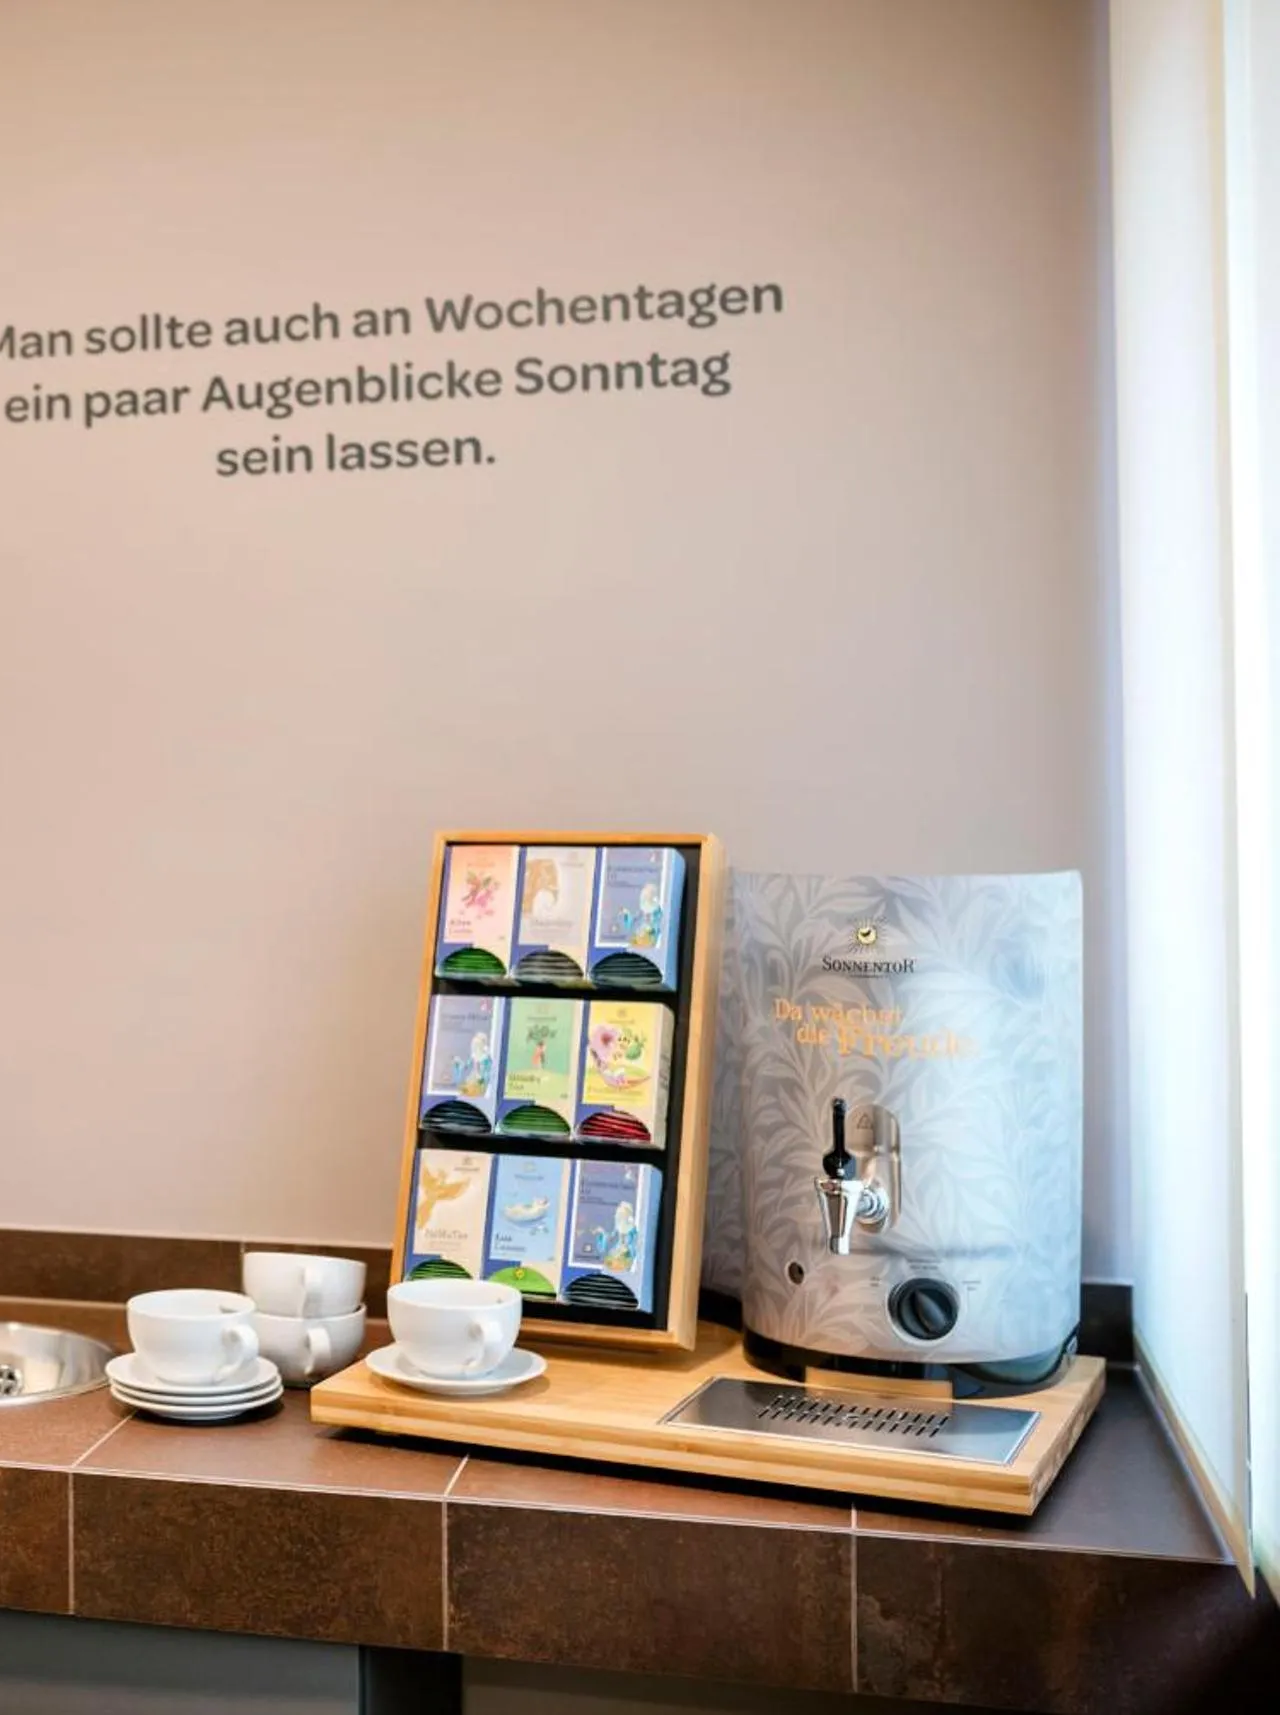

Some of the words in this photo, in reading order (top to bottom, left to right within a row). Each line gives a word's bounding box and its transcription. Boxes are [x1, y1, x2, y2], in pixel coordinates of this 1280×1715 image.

[84, 312, 213, 356] sollte
[223, 302, 341, 346] auch
[351, 306, 412, 338] an
[424, 282, 784, 334] Wochentagen
[3, 382, 72, 424] ein
[83, 385, 192, 429] paar
[200, 357, 504, 420] Augenblicke
[514, 350, 733, 398] Sonntag
[215, 433, 315, 479] sein
[325, 431, 497, 473] lassen.
[821, 954, 917, 974] SONNENTOR
[775, 999, 803, 1021] Da
